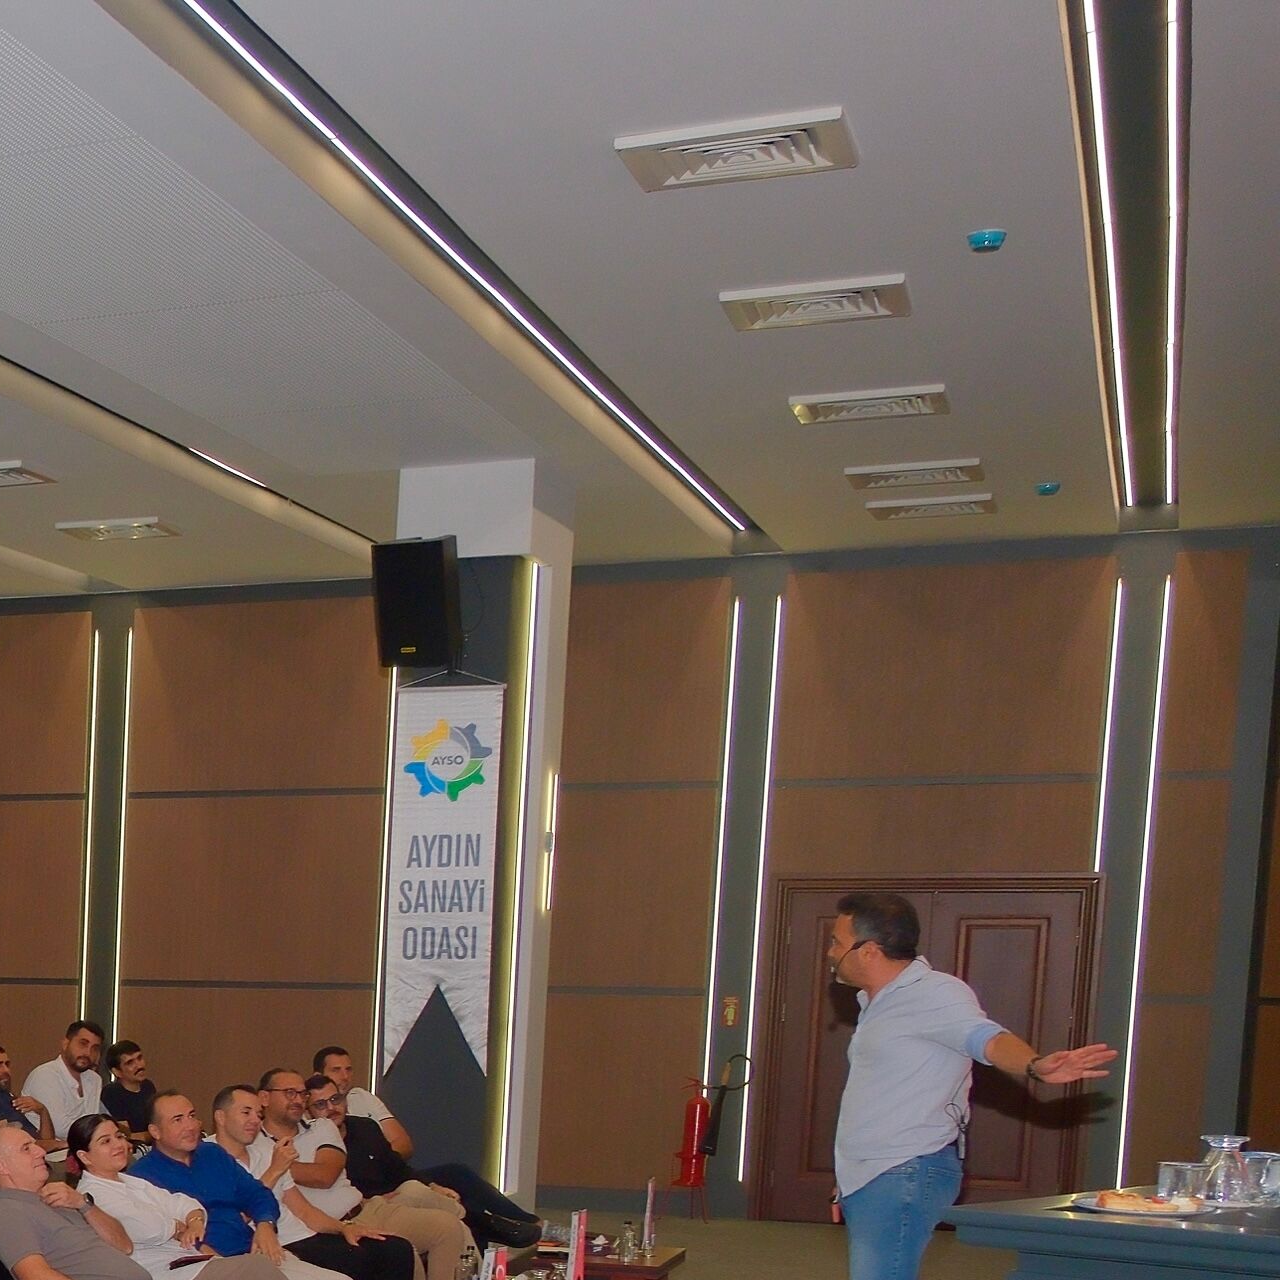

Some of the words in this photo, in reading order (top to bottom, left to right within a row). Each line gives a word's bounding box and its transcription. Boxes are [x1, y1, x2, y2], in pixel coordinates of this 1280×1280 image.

[431, 755, 464, 766] AYSO
[406, 833, 481, 868] AYDIN
[402, 926, 478, 960] ODASI
